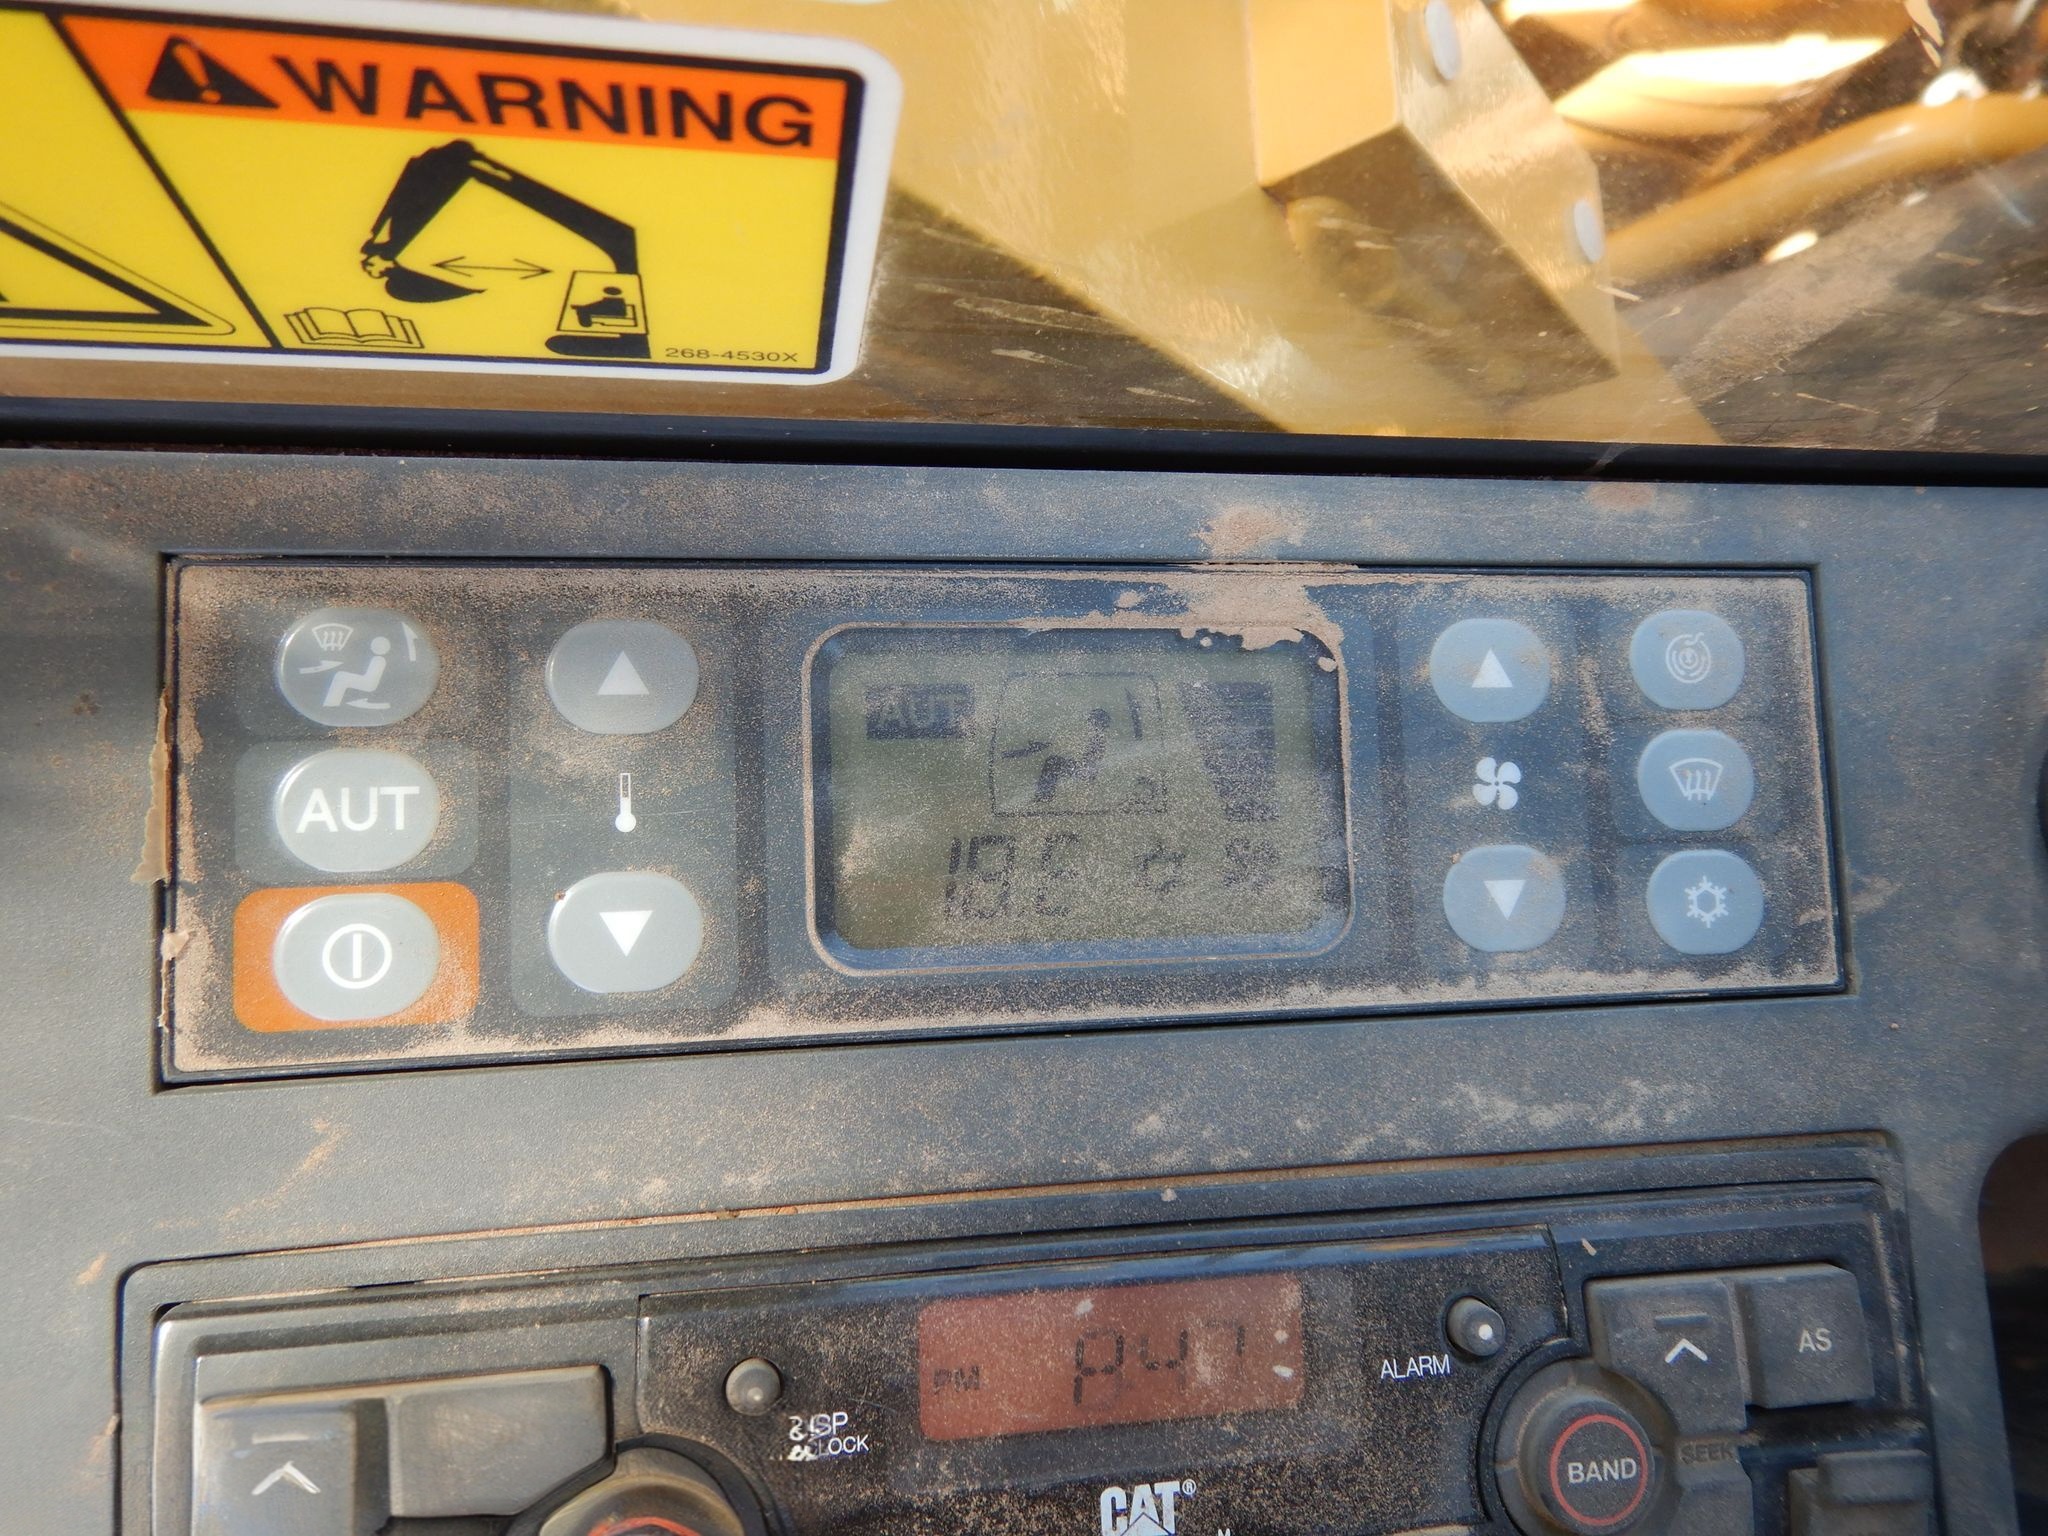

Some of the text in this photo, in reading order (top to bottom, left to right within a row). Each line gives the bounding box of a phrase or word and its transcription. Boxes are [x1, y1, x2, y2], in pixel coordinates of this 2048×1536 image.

[271, 54, 815, 149] WARNING
[664, 346, 799, 363] 268-4530X
[295, 785, 421, 835] AUT
[1798, 1326, 1833, 1354] AS
[1379, 1353, 1451, 1380] ALARM
[1680, 1442, 1736, 1465] SEEK
[1566, 1456, 1639, 1486] BAND
